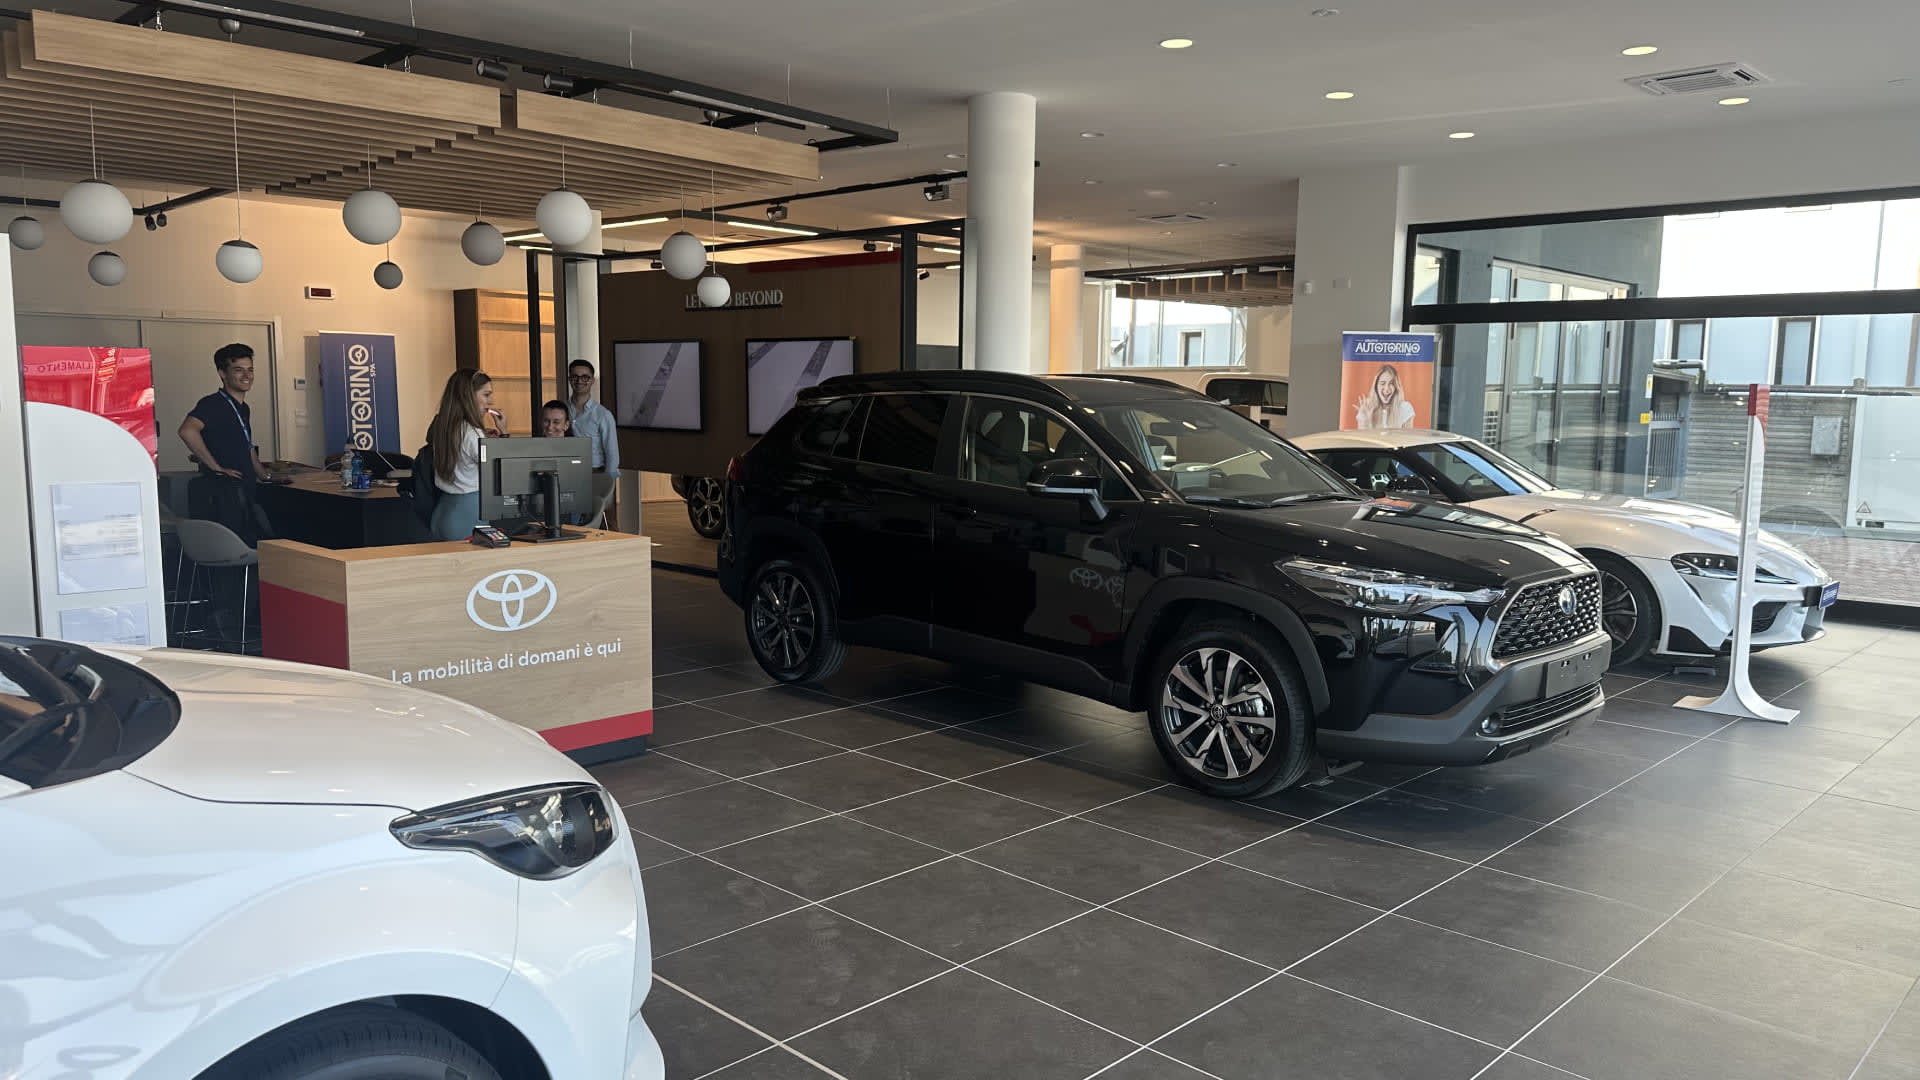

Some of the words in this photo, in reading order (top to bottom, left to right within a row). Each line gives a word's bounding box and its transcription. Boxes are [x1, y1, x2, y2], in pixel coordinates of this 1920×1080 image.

[735, 288, 784, 306] BEYOND
[1355, 342, 1421, 354] AUTOTORINO
[348, 344, 374, 451] OTORINO
[391, 669, 413, 684] La
[417, 656, 493, 682] mobilità
[497, 653, 514, 670] di
[518, 643, 580, 667] domani
[584, 642, 594, 657] è
[597, 637, 621, 658] qui
